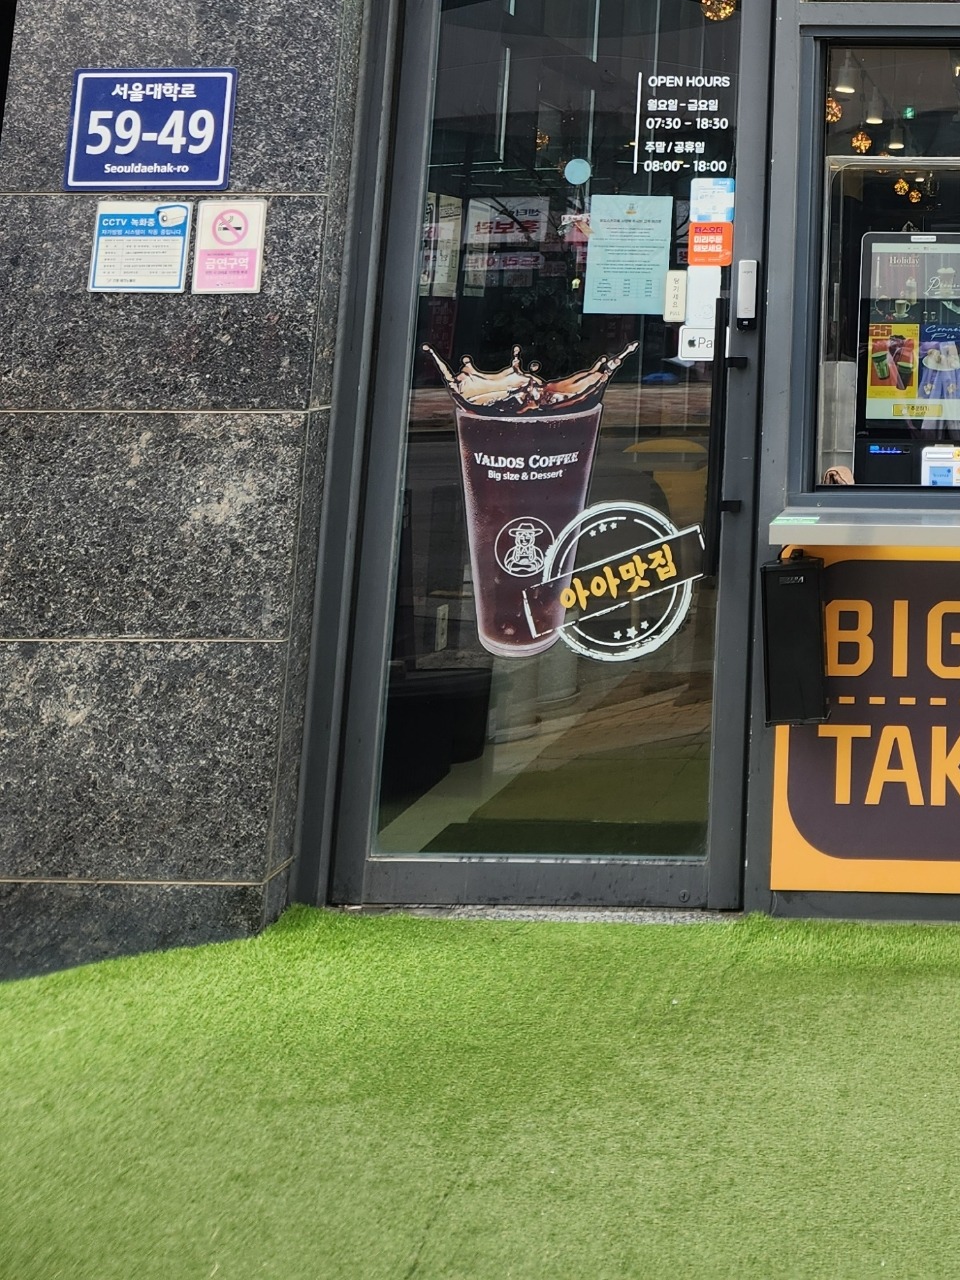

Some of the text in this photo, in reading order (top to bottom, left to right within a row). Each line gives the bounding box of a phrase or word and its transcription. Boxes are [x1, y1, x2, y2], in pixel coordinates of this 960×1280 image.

[648, 76, 731, 87] OPEN HOURS
[111, 82, 197, 101] 서울대학로
[647, 99, 719, 111] 월요일 금요일
[646, 118, 729, 129] 07:30 18:30
[85, 109, 215, 155] 59-49
[644, 141, 666, 153] 주말
[674, 141, 705, 154] 공휴일
[104, 163, 189, 174] Seouldaehak-ro
[643, 160, 727, 172] 08:00 18:00
[102, 218, 127, 226] CCTV
[694, 226, 723, 234] 패스오더
[694, 235, 723, 244] 미리주문
[693, 244, 723, 253] 해보세요
[205, 257, 249, 270] 금연구역
[697, 336, 713, 348] Pa
[474, 451, 579, 468] VALDOS COFFEE
[488, 470, 563, 481] Big size & Dessert
[560, 544, 678, 611] 아아맛집
